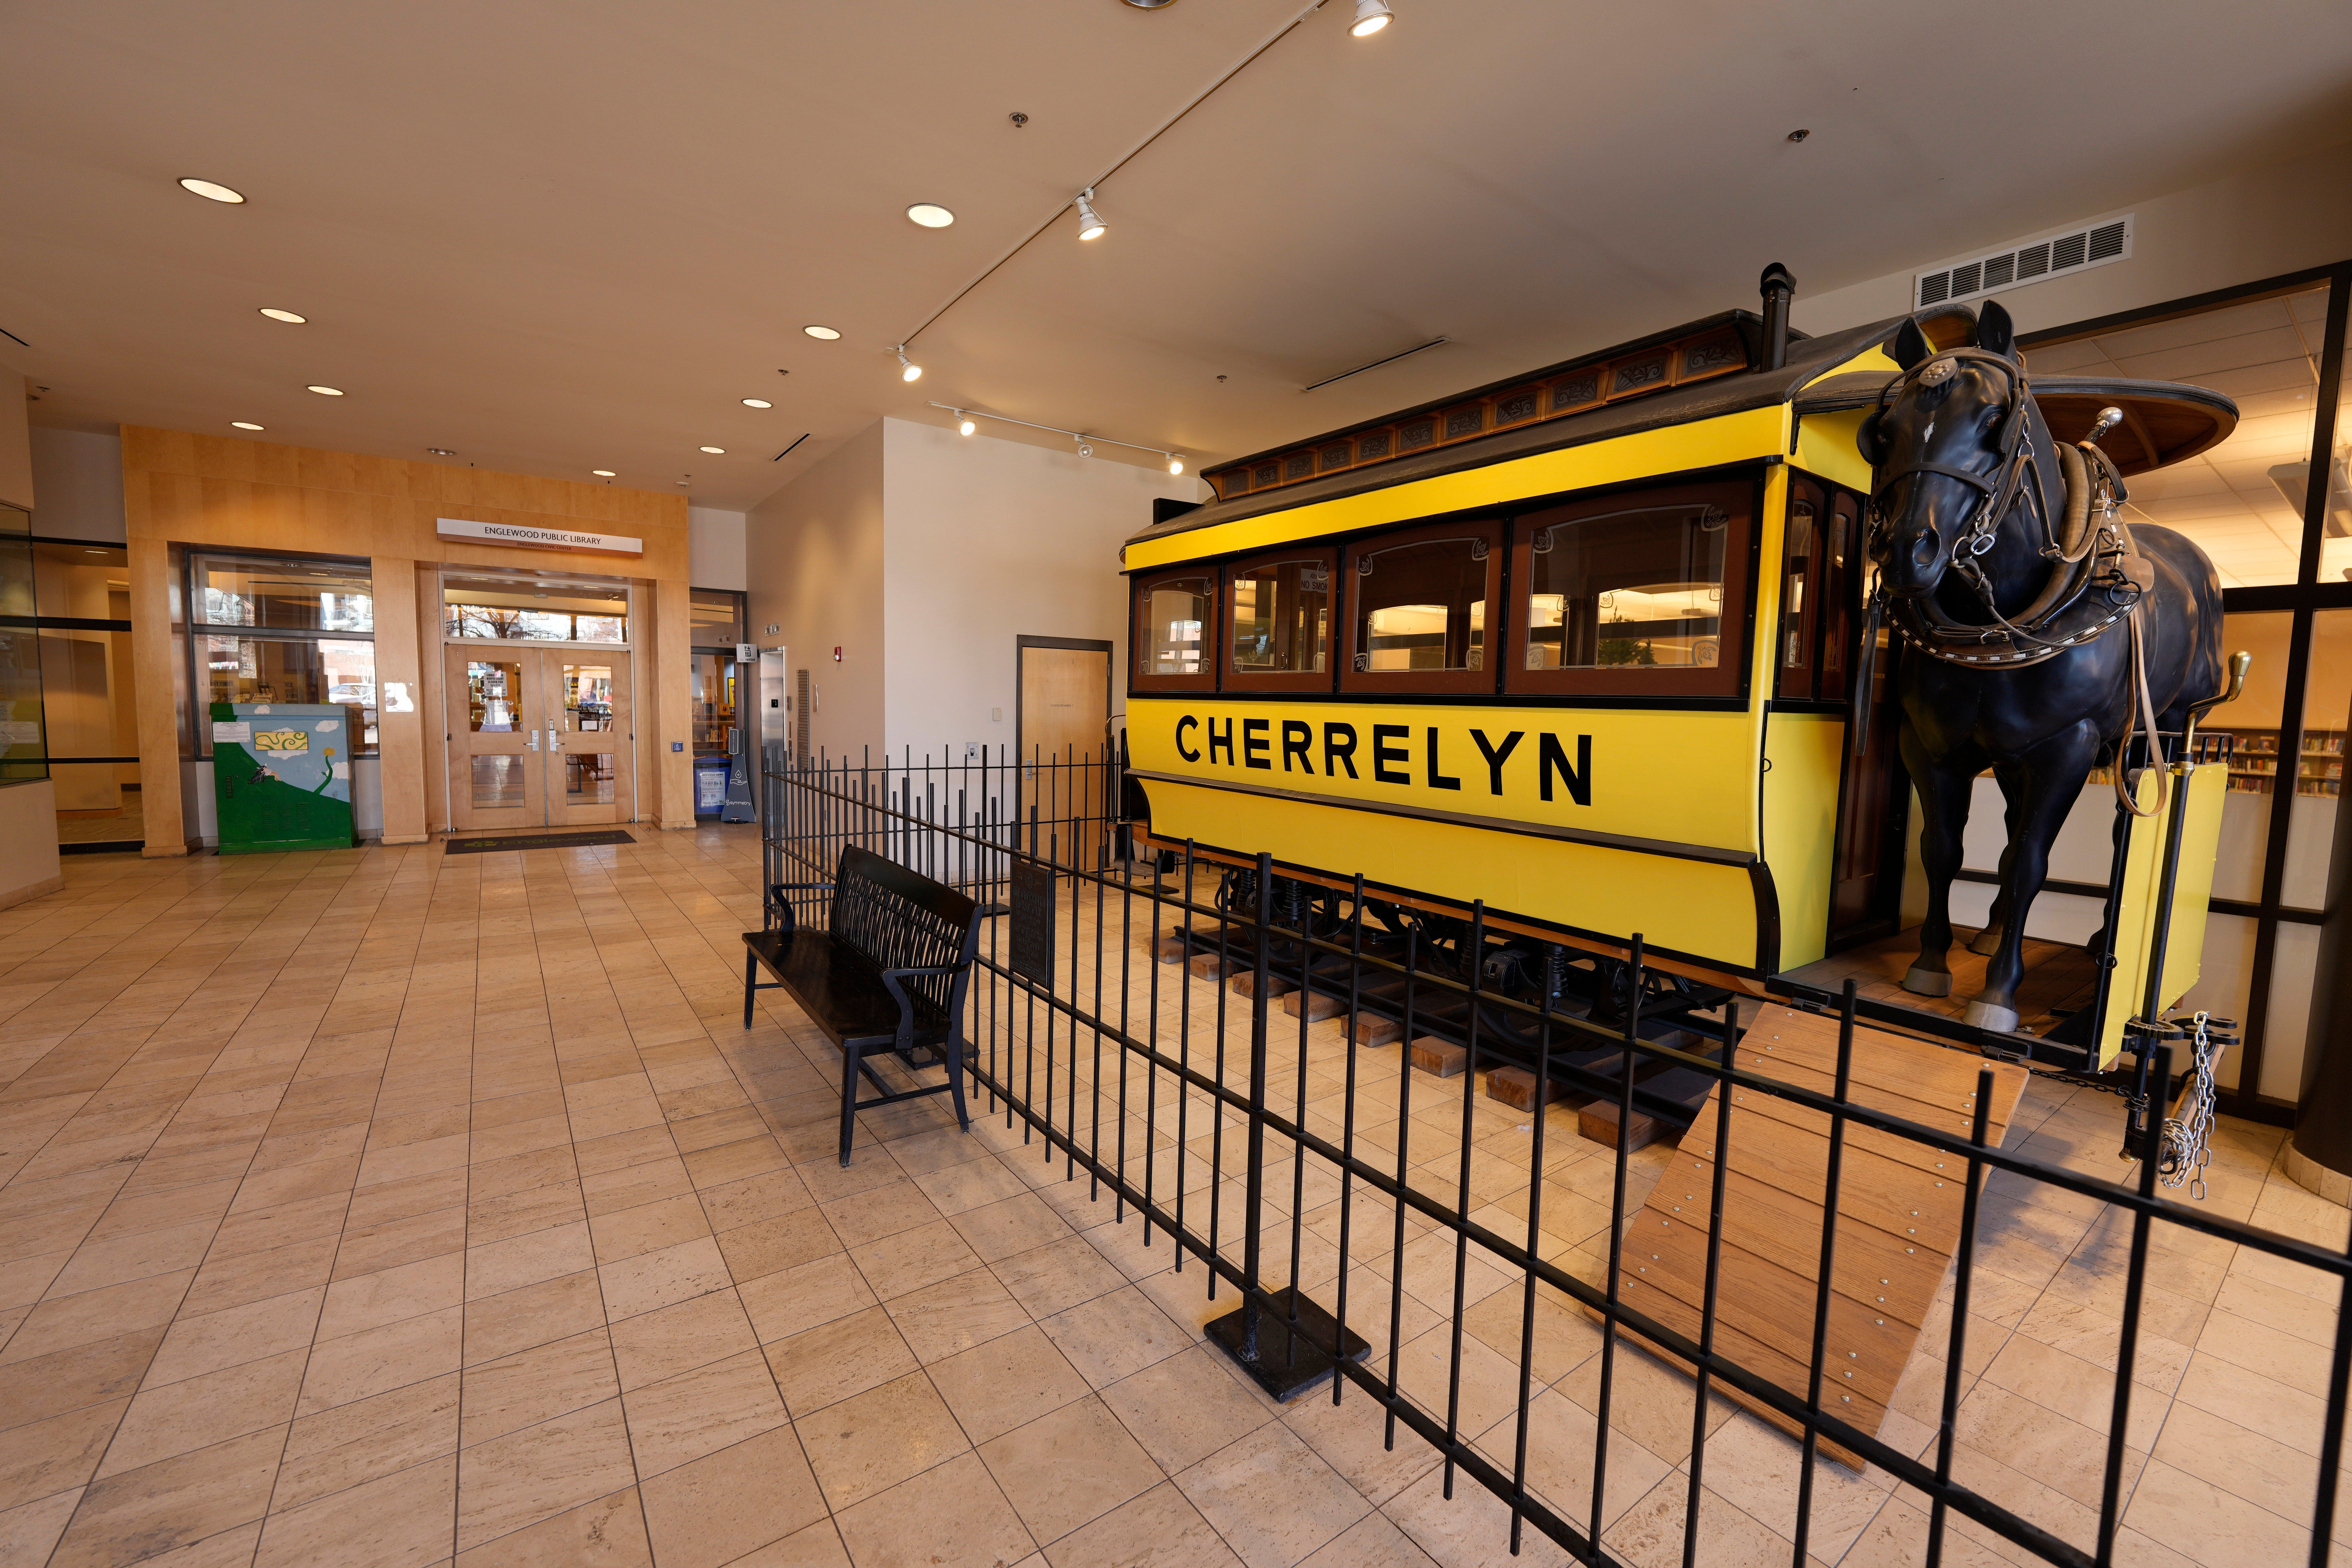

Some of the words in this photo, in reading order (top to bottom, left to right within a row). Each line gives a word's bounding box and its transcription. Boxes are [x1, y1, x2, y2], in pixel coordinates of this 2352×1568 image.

[485, 527, 539, 538] ENGLEWOOD
[542, 533, 568, 542] PUBLIC
[570, 536, 601, 544] LIBRARY
[1301, 580, 1309, 588] NO
[1175, 714, 1592, 806] CHERRELYN
